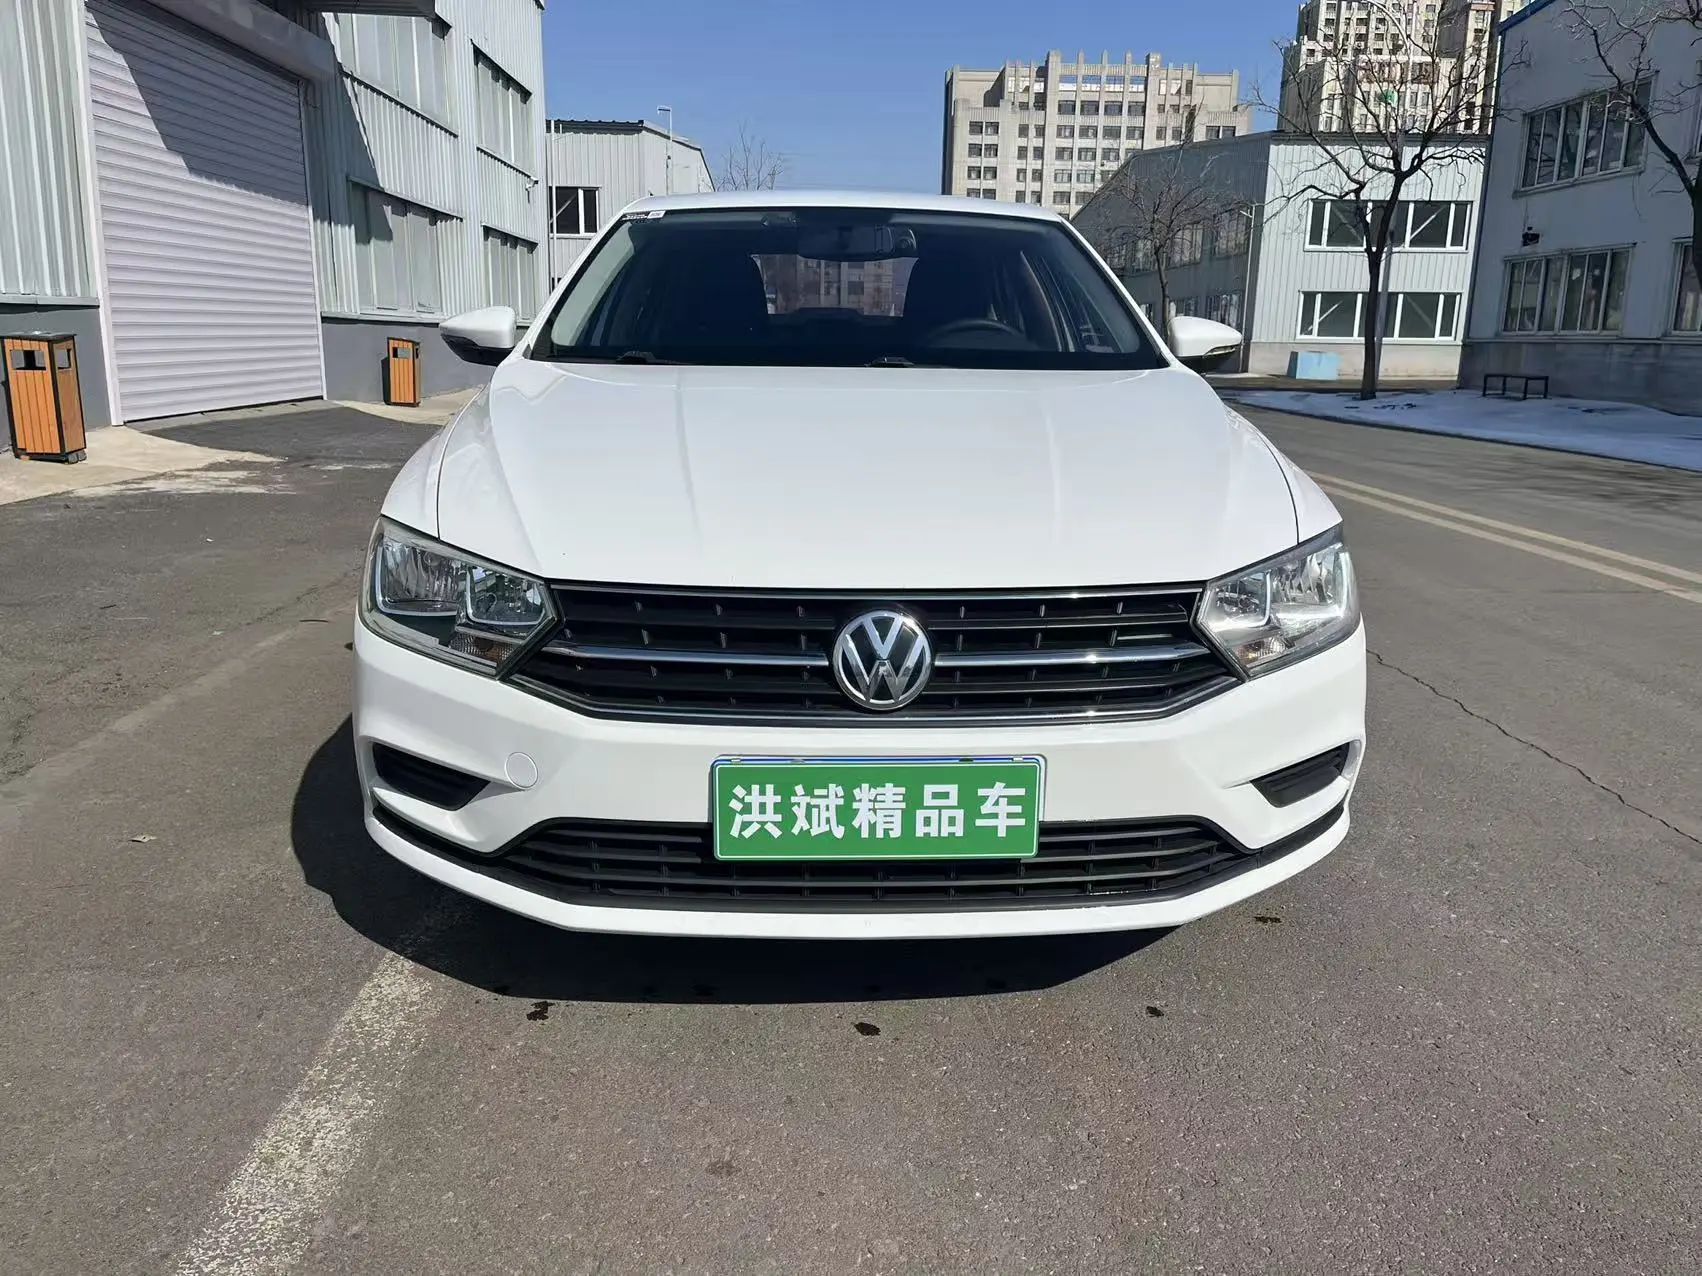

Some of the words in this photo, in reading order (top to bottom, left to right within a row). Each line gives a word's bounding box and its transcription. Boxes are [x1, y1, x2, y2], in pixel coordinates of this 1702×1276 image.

[838, 612, 930, 707] VW
[729, 782, 1026, 839] 洪斌精品车
